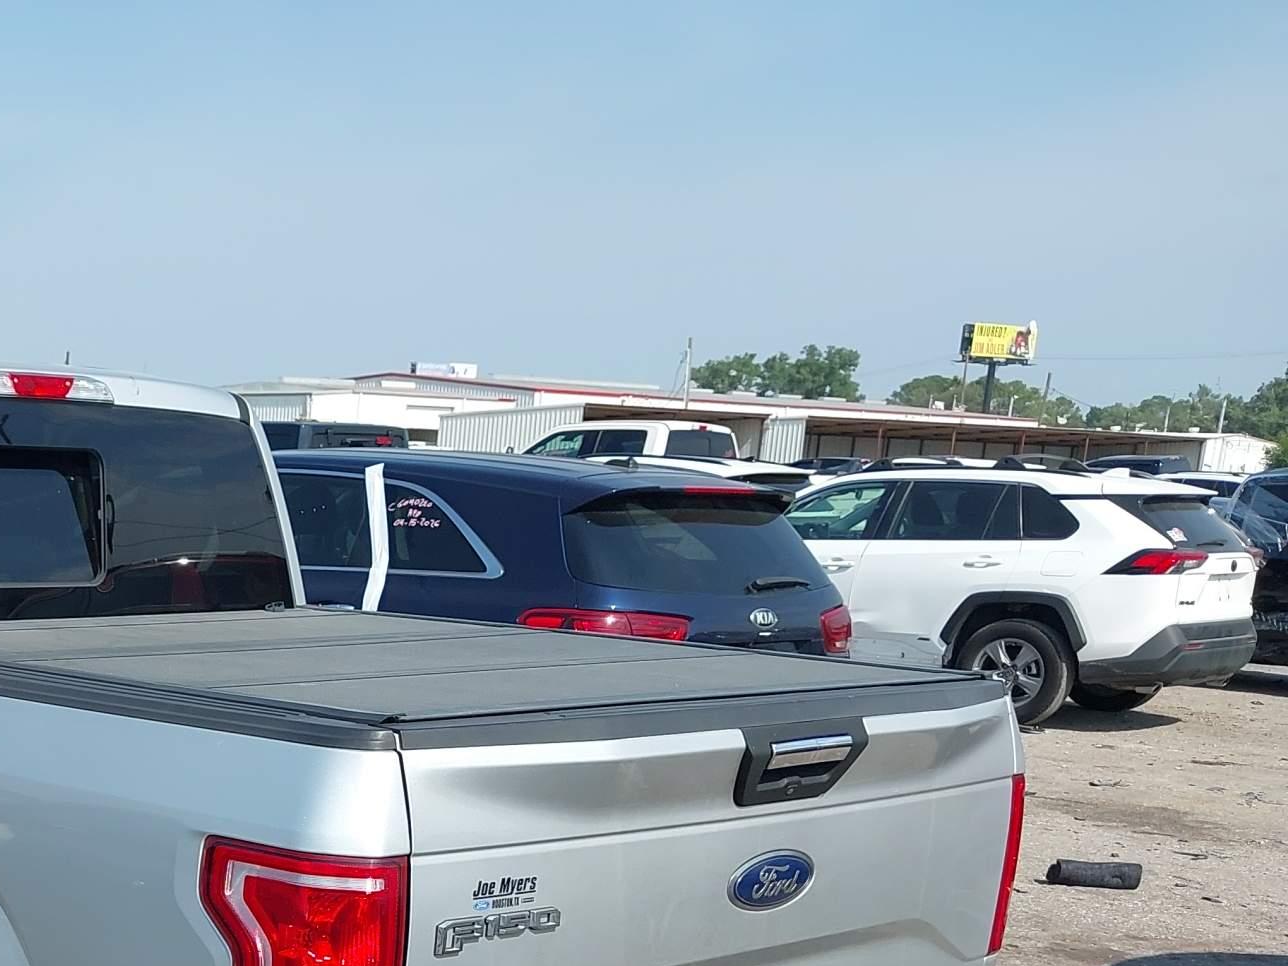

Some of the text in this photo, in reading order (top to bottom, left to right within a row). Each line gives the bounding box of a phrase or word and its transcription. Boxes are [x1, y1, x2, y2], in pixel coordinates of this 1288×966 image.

[976, 324, 1008, 338] INJURED?
[473, 876, 537, 896] Joe Myers
